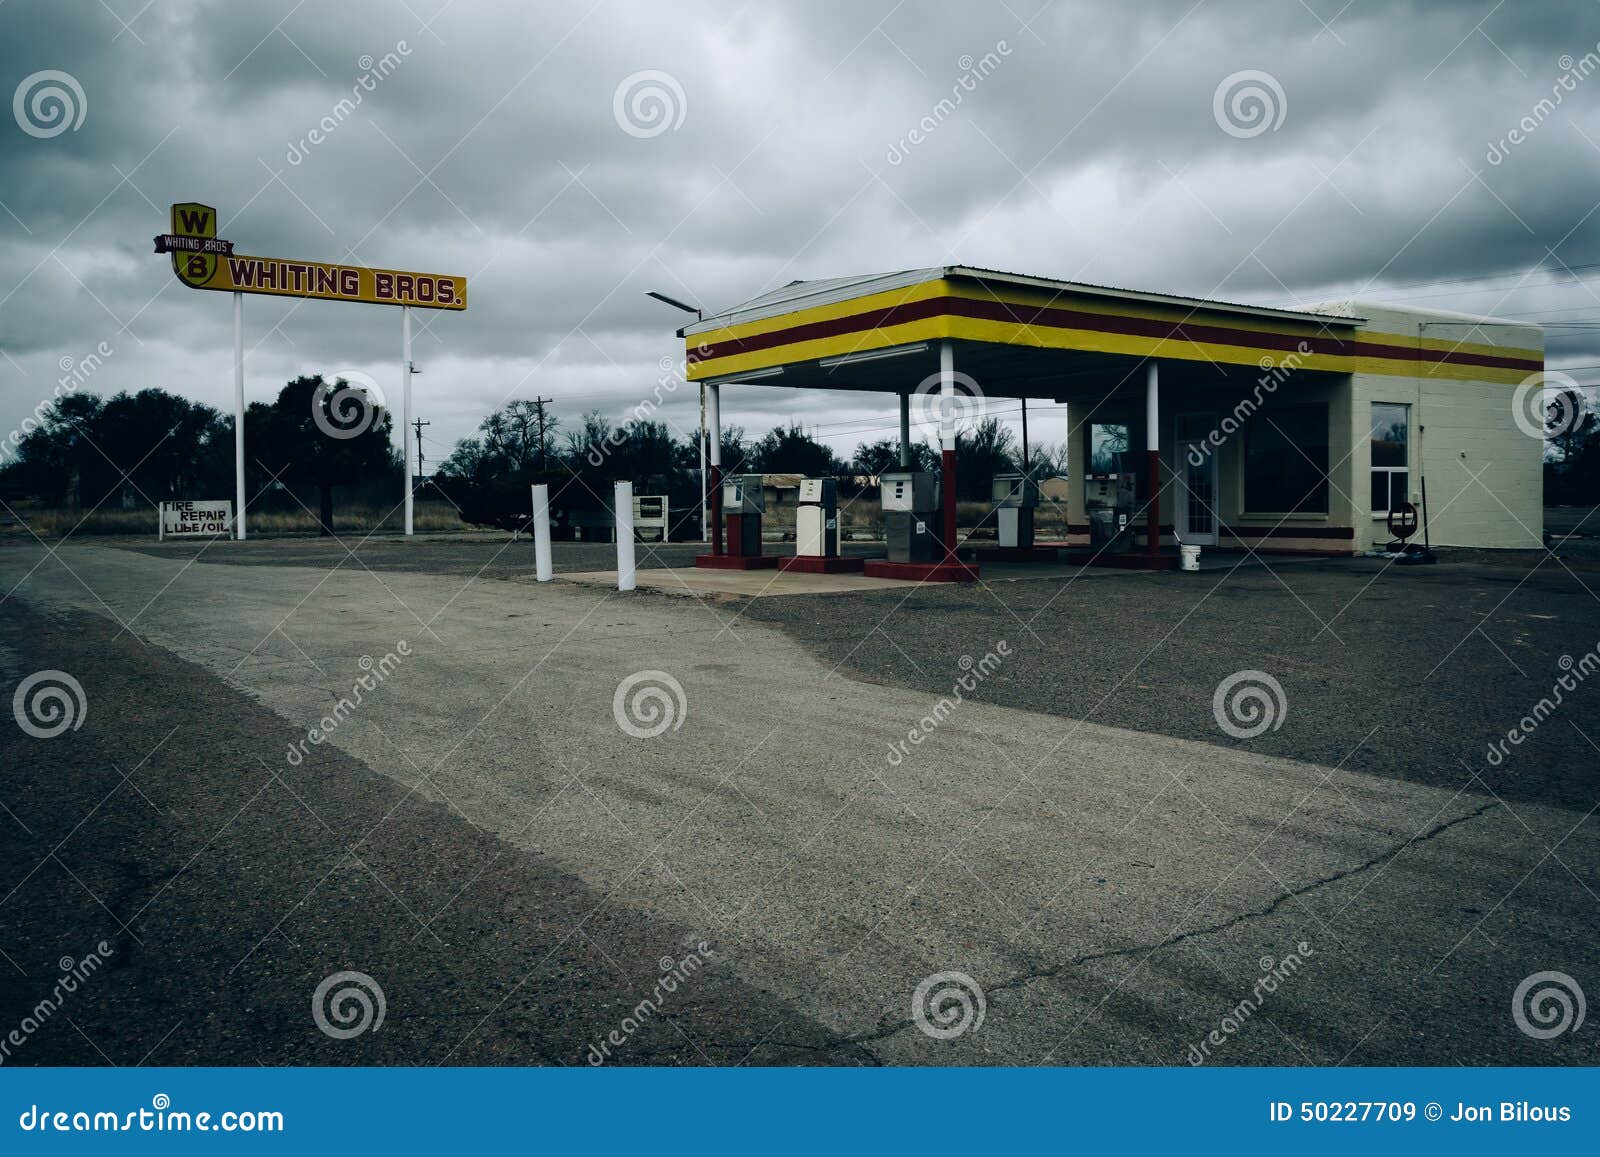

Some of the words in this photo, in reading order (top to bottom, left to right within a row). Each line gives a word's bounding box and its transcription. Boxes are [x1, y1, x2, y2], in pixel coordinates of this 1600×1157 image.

[180, 210, 209, 233] W
[164, 236, 200, 250] WHITING
[205, 240, 227, 252] BROS
[187, 255, 208, 278] B
[228, 257, 360, 296] WHITING
[375, 273, 463, 306] BROS.
[163, 502, 194, 511] TIRE
[180, 511, 227, 521] REPAIR
